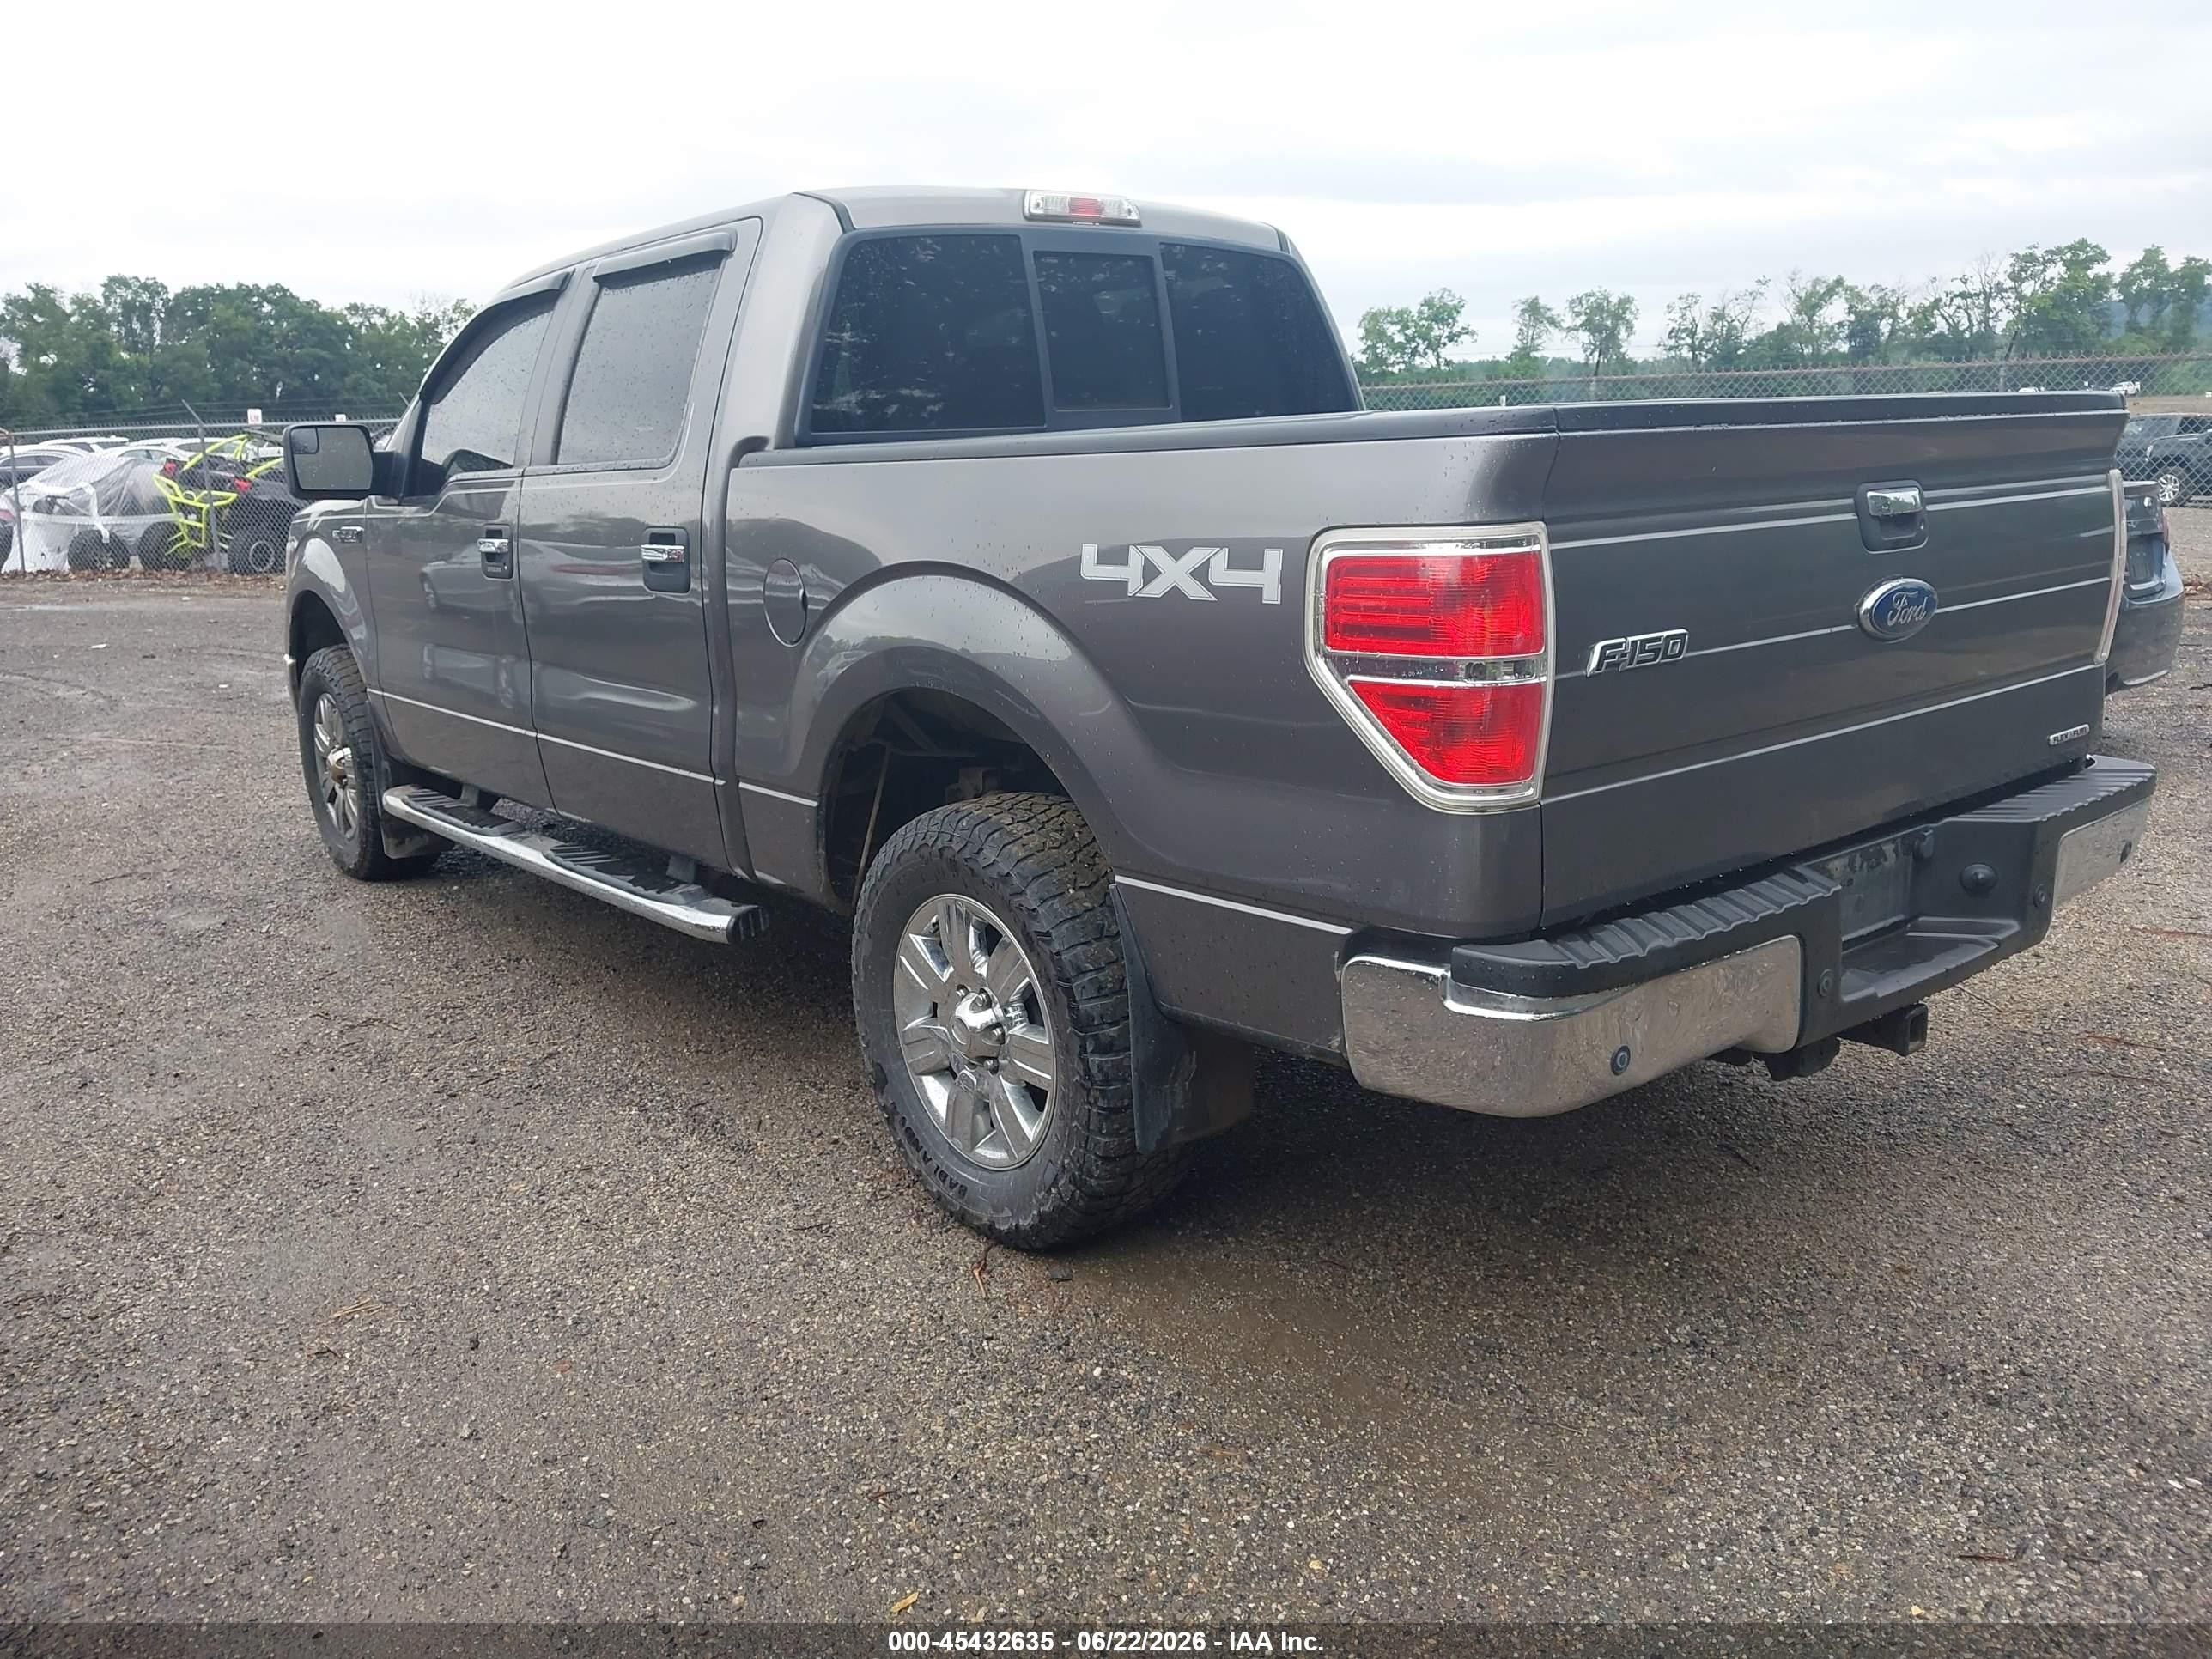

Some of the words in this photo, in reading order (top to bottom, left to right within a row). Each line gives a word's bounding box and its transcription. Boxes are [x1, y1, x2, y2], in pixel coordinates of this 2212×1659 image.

[1080, 543, 1284, 605] 4X4
[1887, 590, 1929, 626] Ford
[1586, 628, 1689, 678] F-150
